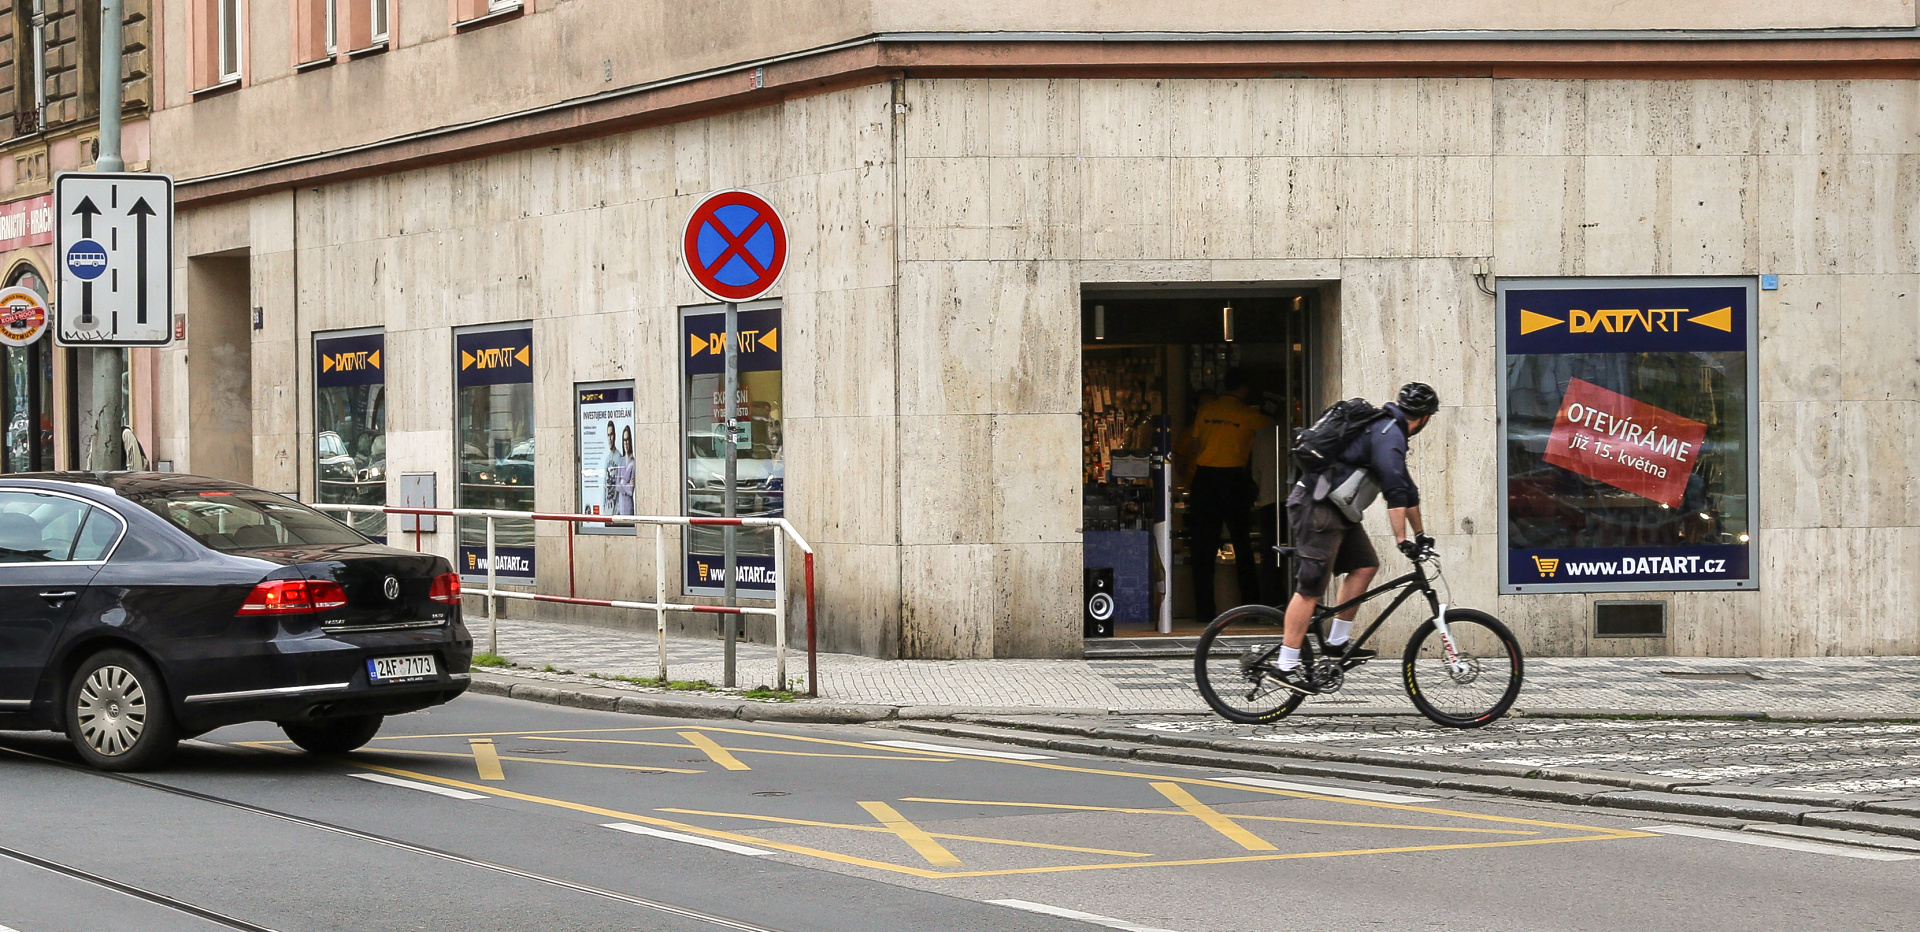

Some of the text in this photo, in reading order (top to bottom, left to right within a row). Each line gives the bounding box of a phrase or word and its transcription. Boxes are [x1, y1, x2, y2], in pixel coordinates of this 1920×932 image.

[1569, 308, 1689, 333] DATART
[709, 330, 760, 355] DAART
[335, 351, 369, 371] DATART
[476, 347, 516, 369] DATART
[607, 410, 613, 418] DO
[1567, 402, 1693, 463] OTEVÍRÁME
[1568, 432, 1667, 480] již 15. května
[477, 555, 529, 572] wwDATART.cz
[1565, 555, 1726, 577] www.DATART.cz
[377, 657, 431, 676] 2AF 7173
